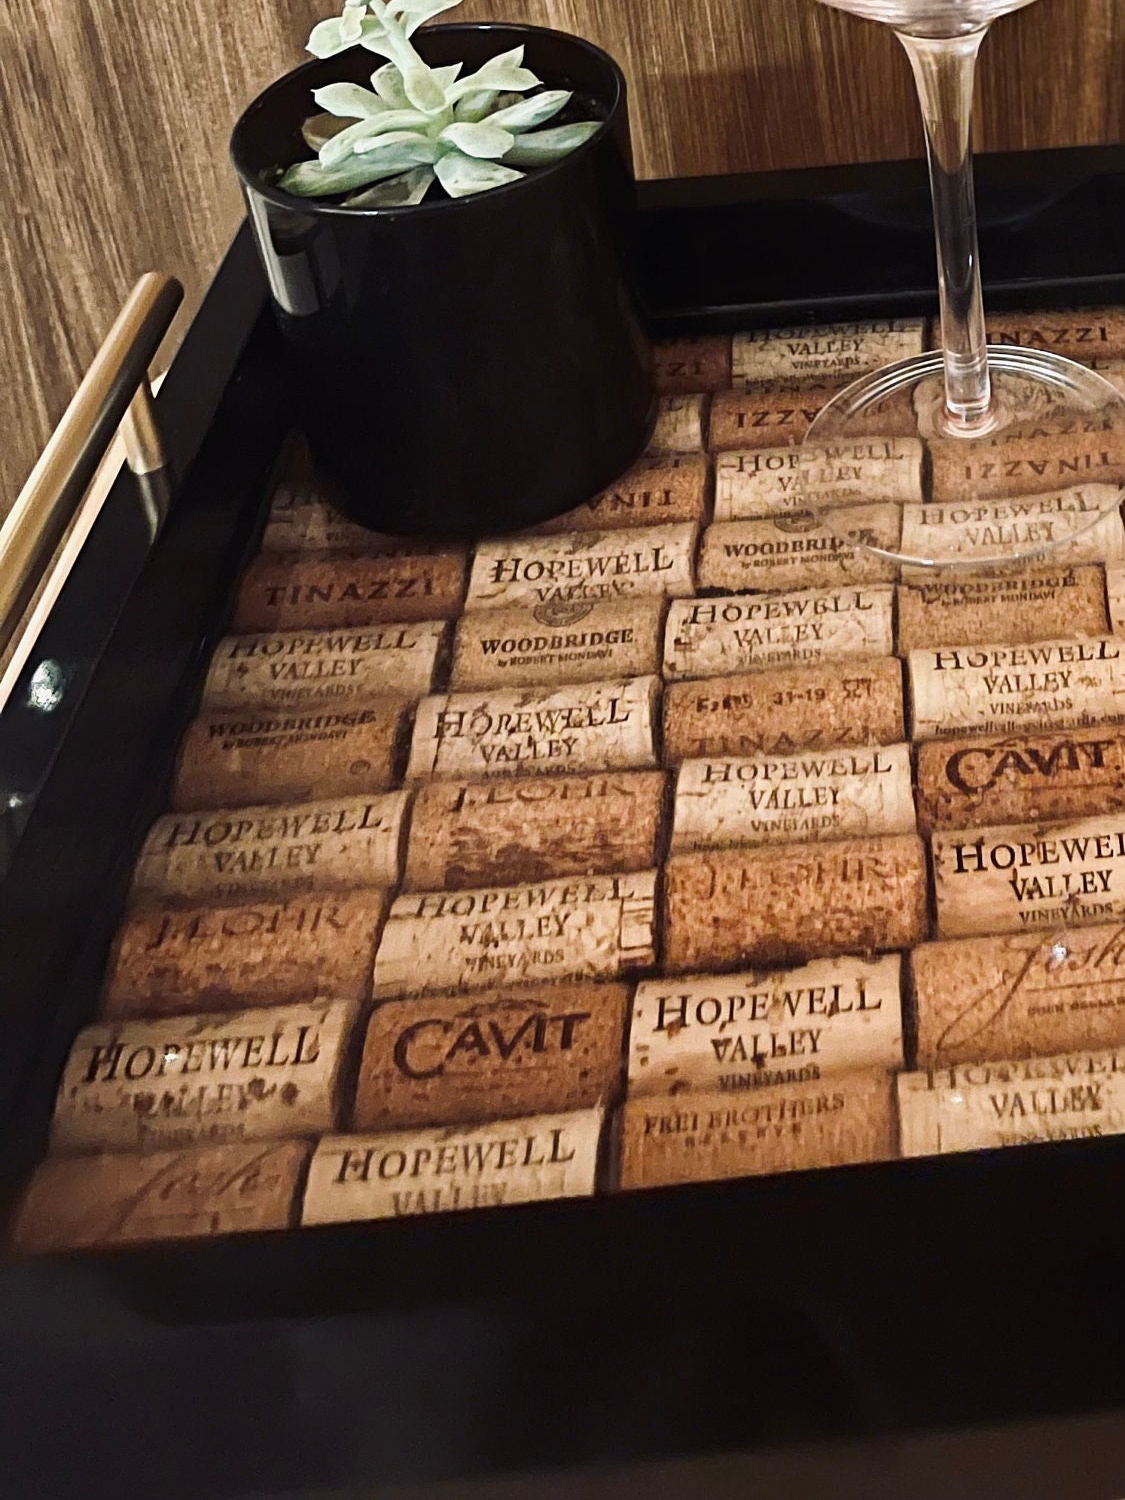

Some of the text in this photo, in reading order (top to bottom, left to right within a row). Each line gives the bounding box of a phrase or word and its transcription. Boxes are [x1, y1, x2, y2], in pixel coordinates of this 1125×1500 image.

[787, 338, 865, 356] VALLEY
[986, 326, 1109, 347] INAZZI
[964, 451, 1120, 480] TINAZZI
[920, 491, 1100, 525] HOPEWELL
[965, 521, 1055, 547] VALLEY
[489, 546, 675, 584] HOPEWELL
[753, 555, 792, 569] ROBERT
[264, 577, 435, 607] TINAZZI
[925, 574, 1078, 596] WOODBRIDGE
[686, 590, 873, 625] HOPEWELL
[228, 630, 418, 660] HOPEWELL
[480, 627, 634, 656] WOODBRIDGE
[733, 622, 825, 648] VALLEY
[269, 658, 363, 681] VALLEY
[509, 654, 556, 667] ROBERT
[557, 649, 613, 664] MONDAVI
[933, 640, 1120, 671] HOPEWELL
[982, 670, 1074, 695] VALLEY
[208, 709, 377, 739] WOODBRIDGE
[432, 697, 631, 739] HOPEWELL
[479, 737, 579, 764] VALLEY
[701, 751, 893, 784] HOPEWELL
[945, 739, 1115, 794] CAVIT
[749, 786, 841, 811] VALLEY
[165, 804, 384, 848] HOPEWELL
[213, 843, 322, 874] VALLEY
[415, 878, 635, 918] HOPEWELL
[1009, 868, 1114, 902] VALLEY
[1018, 902, 1115, 923] VINEYARDS
[459, 912, 571, 948] VALLEY
[652, 977, 882, 1033] HOPEWELL
[81, 1025, 322, 1084] HOPEWELL
[392, 1011, 592, 1081] CAVIT
[711, 1027, 823, 1063] VALLEY
[989, 1083, 1103, 1119] VALLEY
[331, 1129, 577, 1184] HOPEWELL
